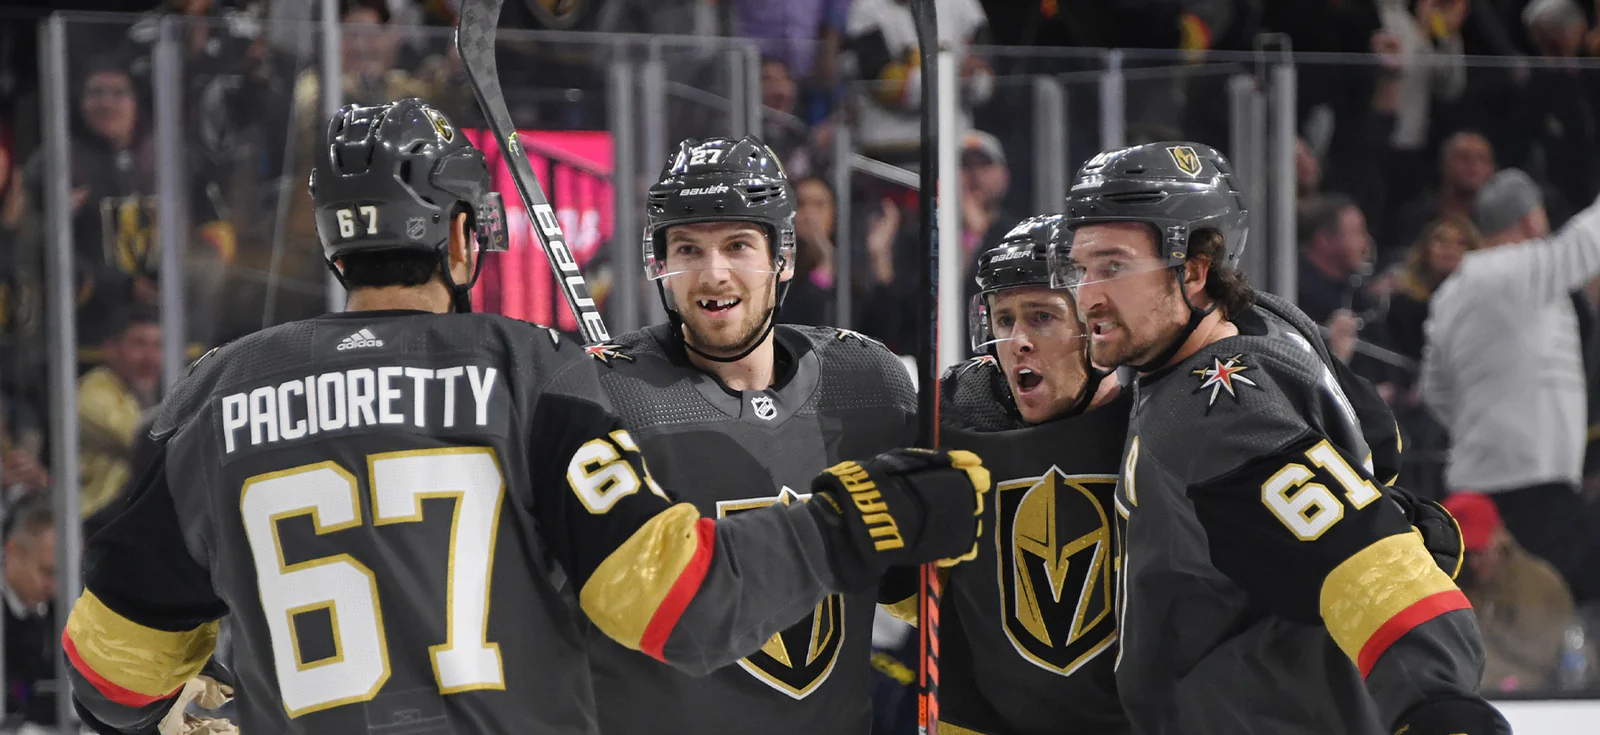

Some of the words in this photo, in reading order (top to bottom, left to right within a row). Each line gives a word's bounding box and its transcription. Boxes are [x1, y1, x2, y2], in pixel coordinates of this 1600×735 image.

[690, 149, 723, 165] 27
[680, 184, 729, 196] BAUER
[336, 206, 378, 238] 67
[990, 250, 1031, 263] BAUER
[336, 339, 384, 351] adidas
[222, 365, 497, 454] PACIORETTY
[1261, 438, 1383, 541] 61
[240, 446, 506, 719] 67
